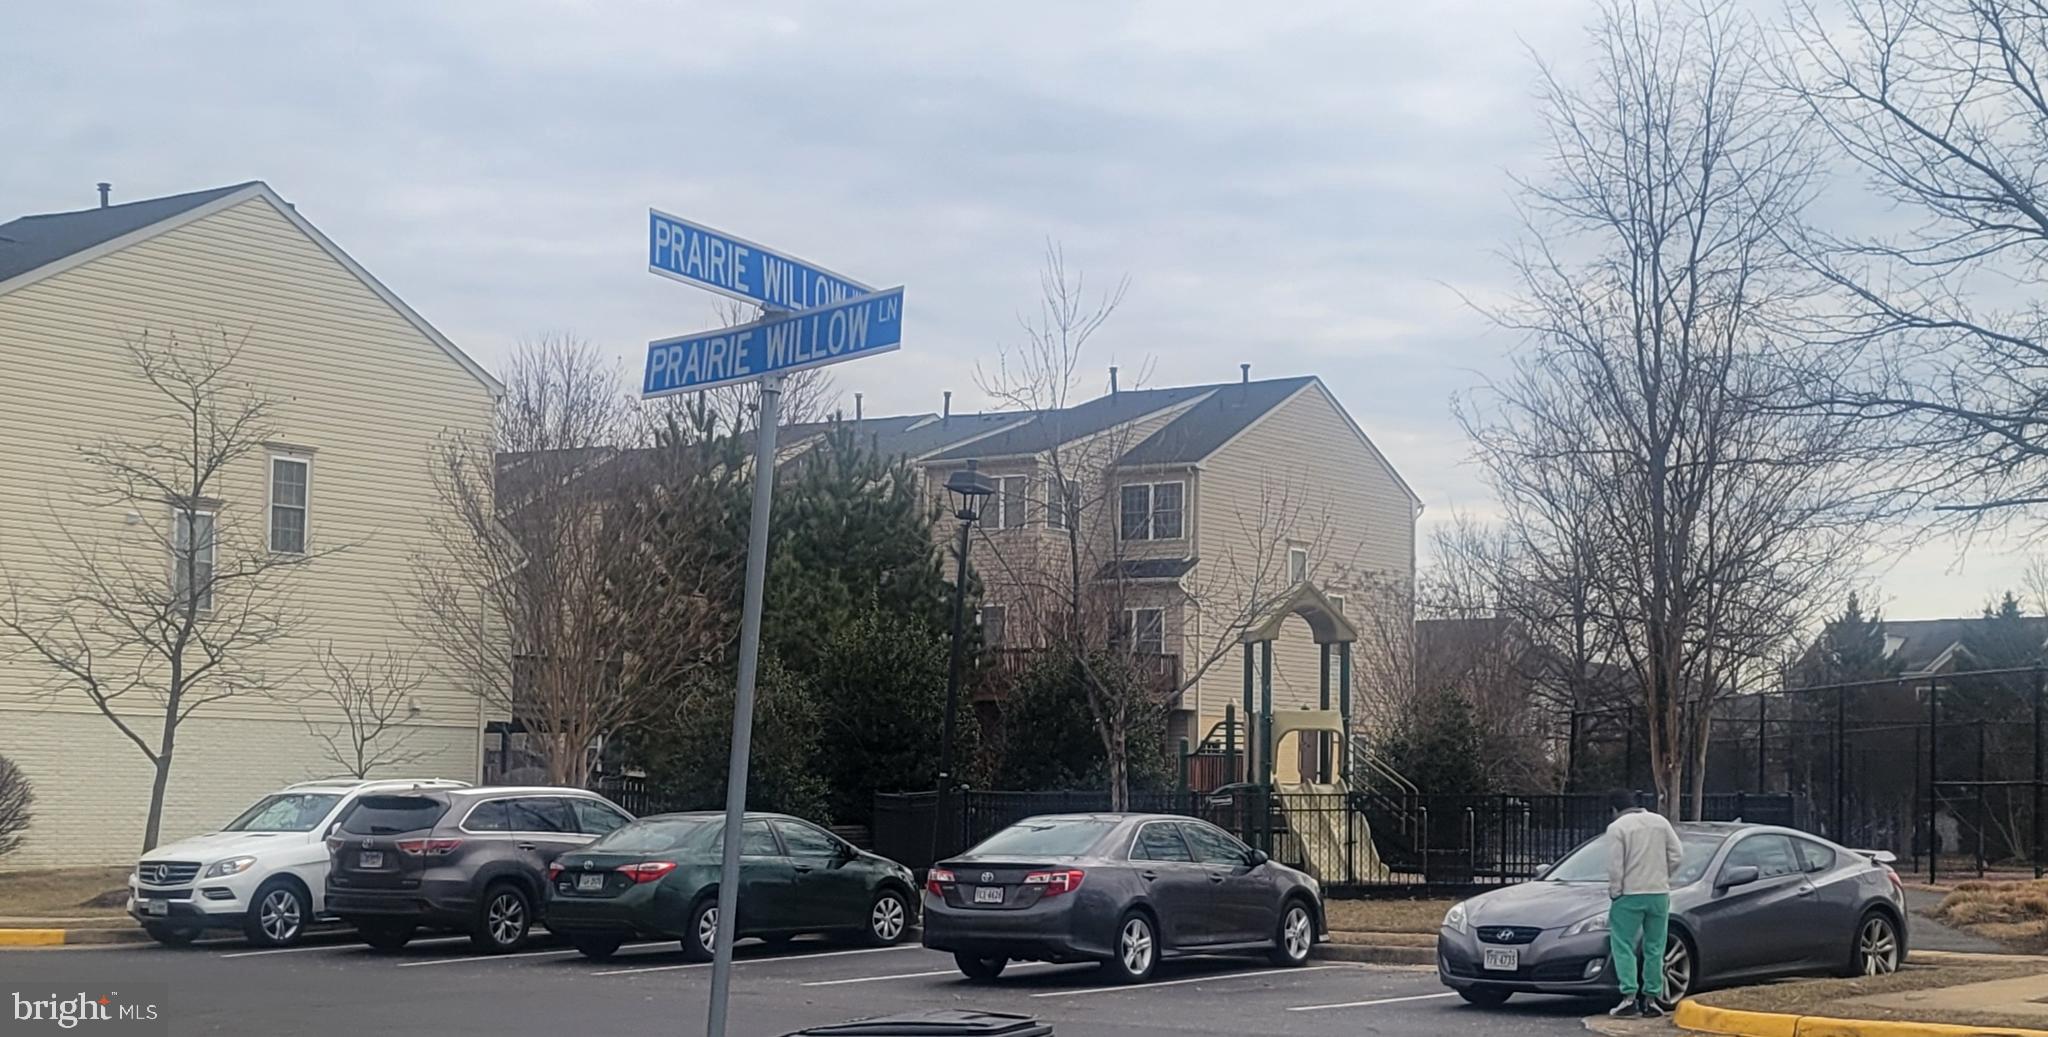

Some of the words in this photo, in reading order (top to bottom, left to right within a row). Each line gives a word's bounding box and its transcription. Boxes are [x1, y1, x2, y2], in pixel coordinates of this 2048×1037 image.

[656, 219, 749, 292] PRAIRIE
[649, 331, 752, 390] PRAIRIE
[766, 303, 871, 369] WILLOW
[879, 296, 898, 322] LN
